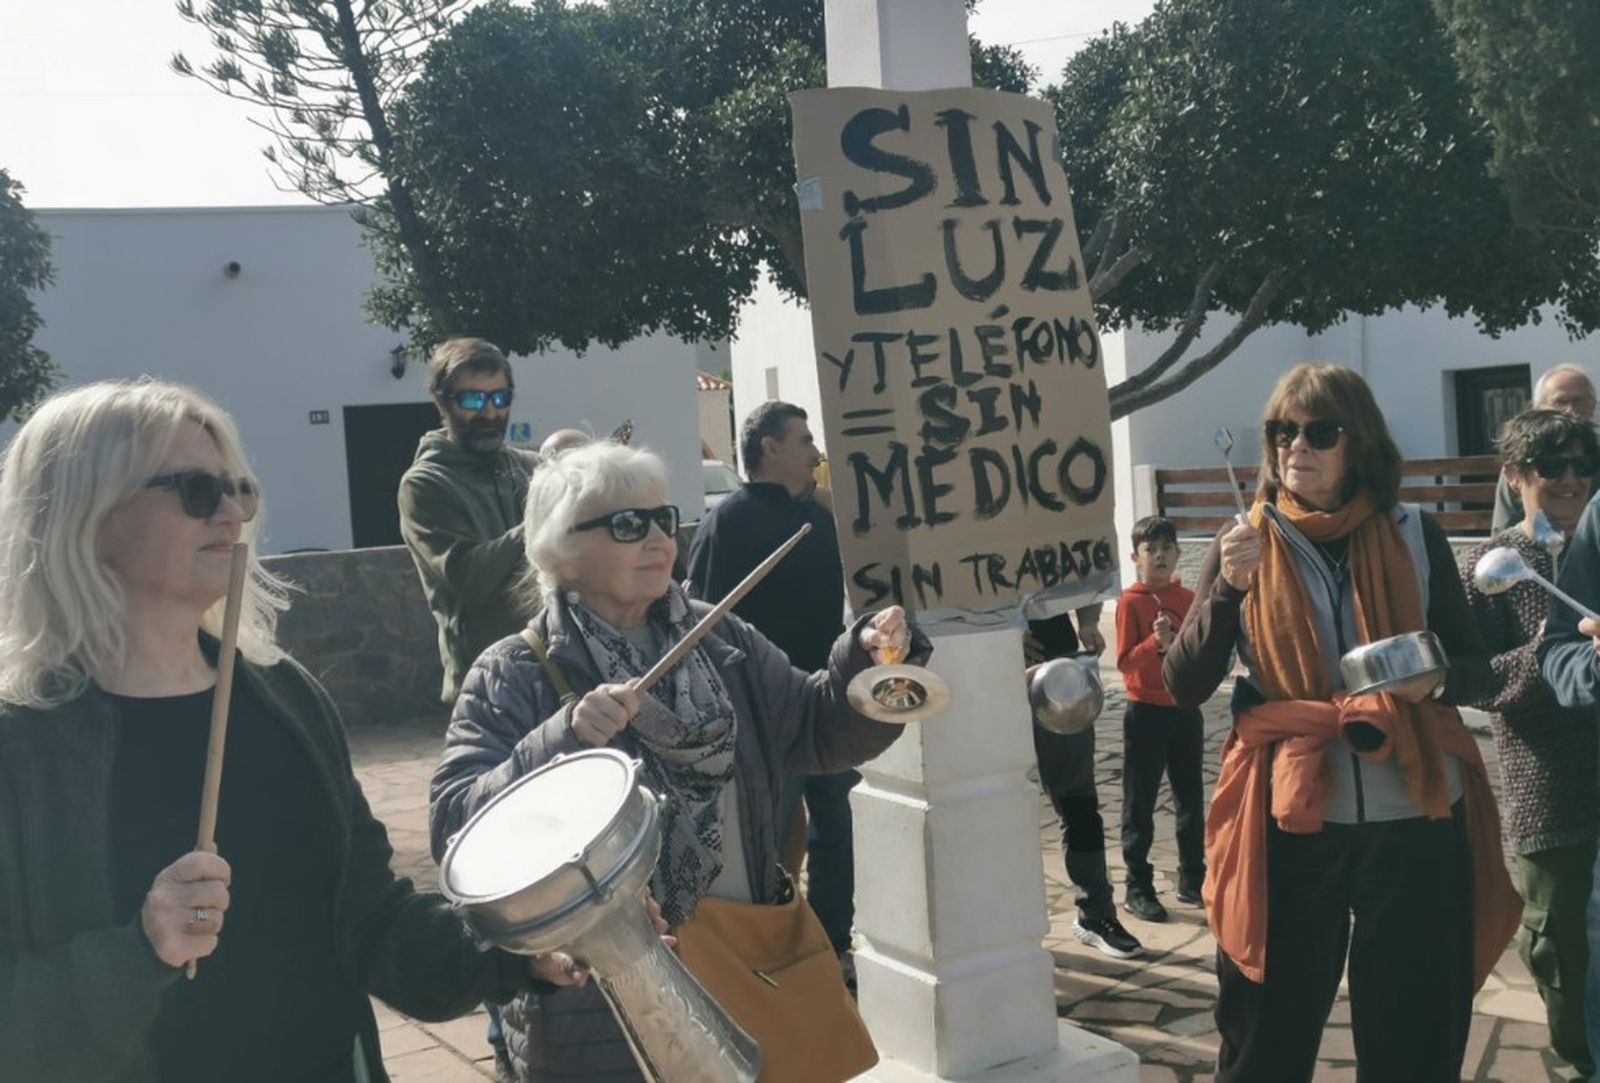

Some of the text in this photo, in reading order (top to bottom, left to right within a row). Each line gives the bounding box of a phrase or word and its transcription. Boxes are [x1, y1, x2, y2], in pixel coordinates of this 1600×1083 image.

[841, 104, 1052, 216] SIN
[839, 215, 1080, 315] LUZ
[822, 306, 1099, 394] Y TELÉFONO
[918, 379, 1042, 448] SIN
[853, 536, 1113, 609] SIN TRABAJO
